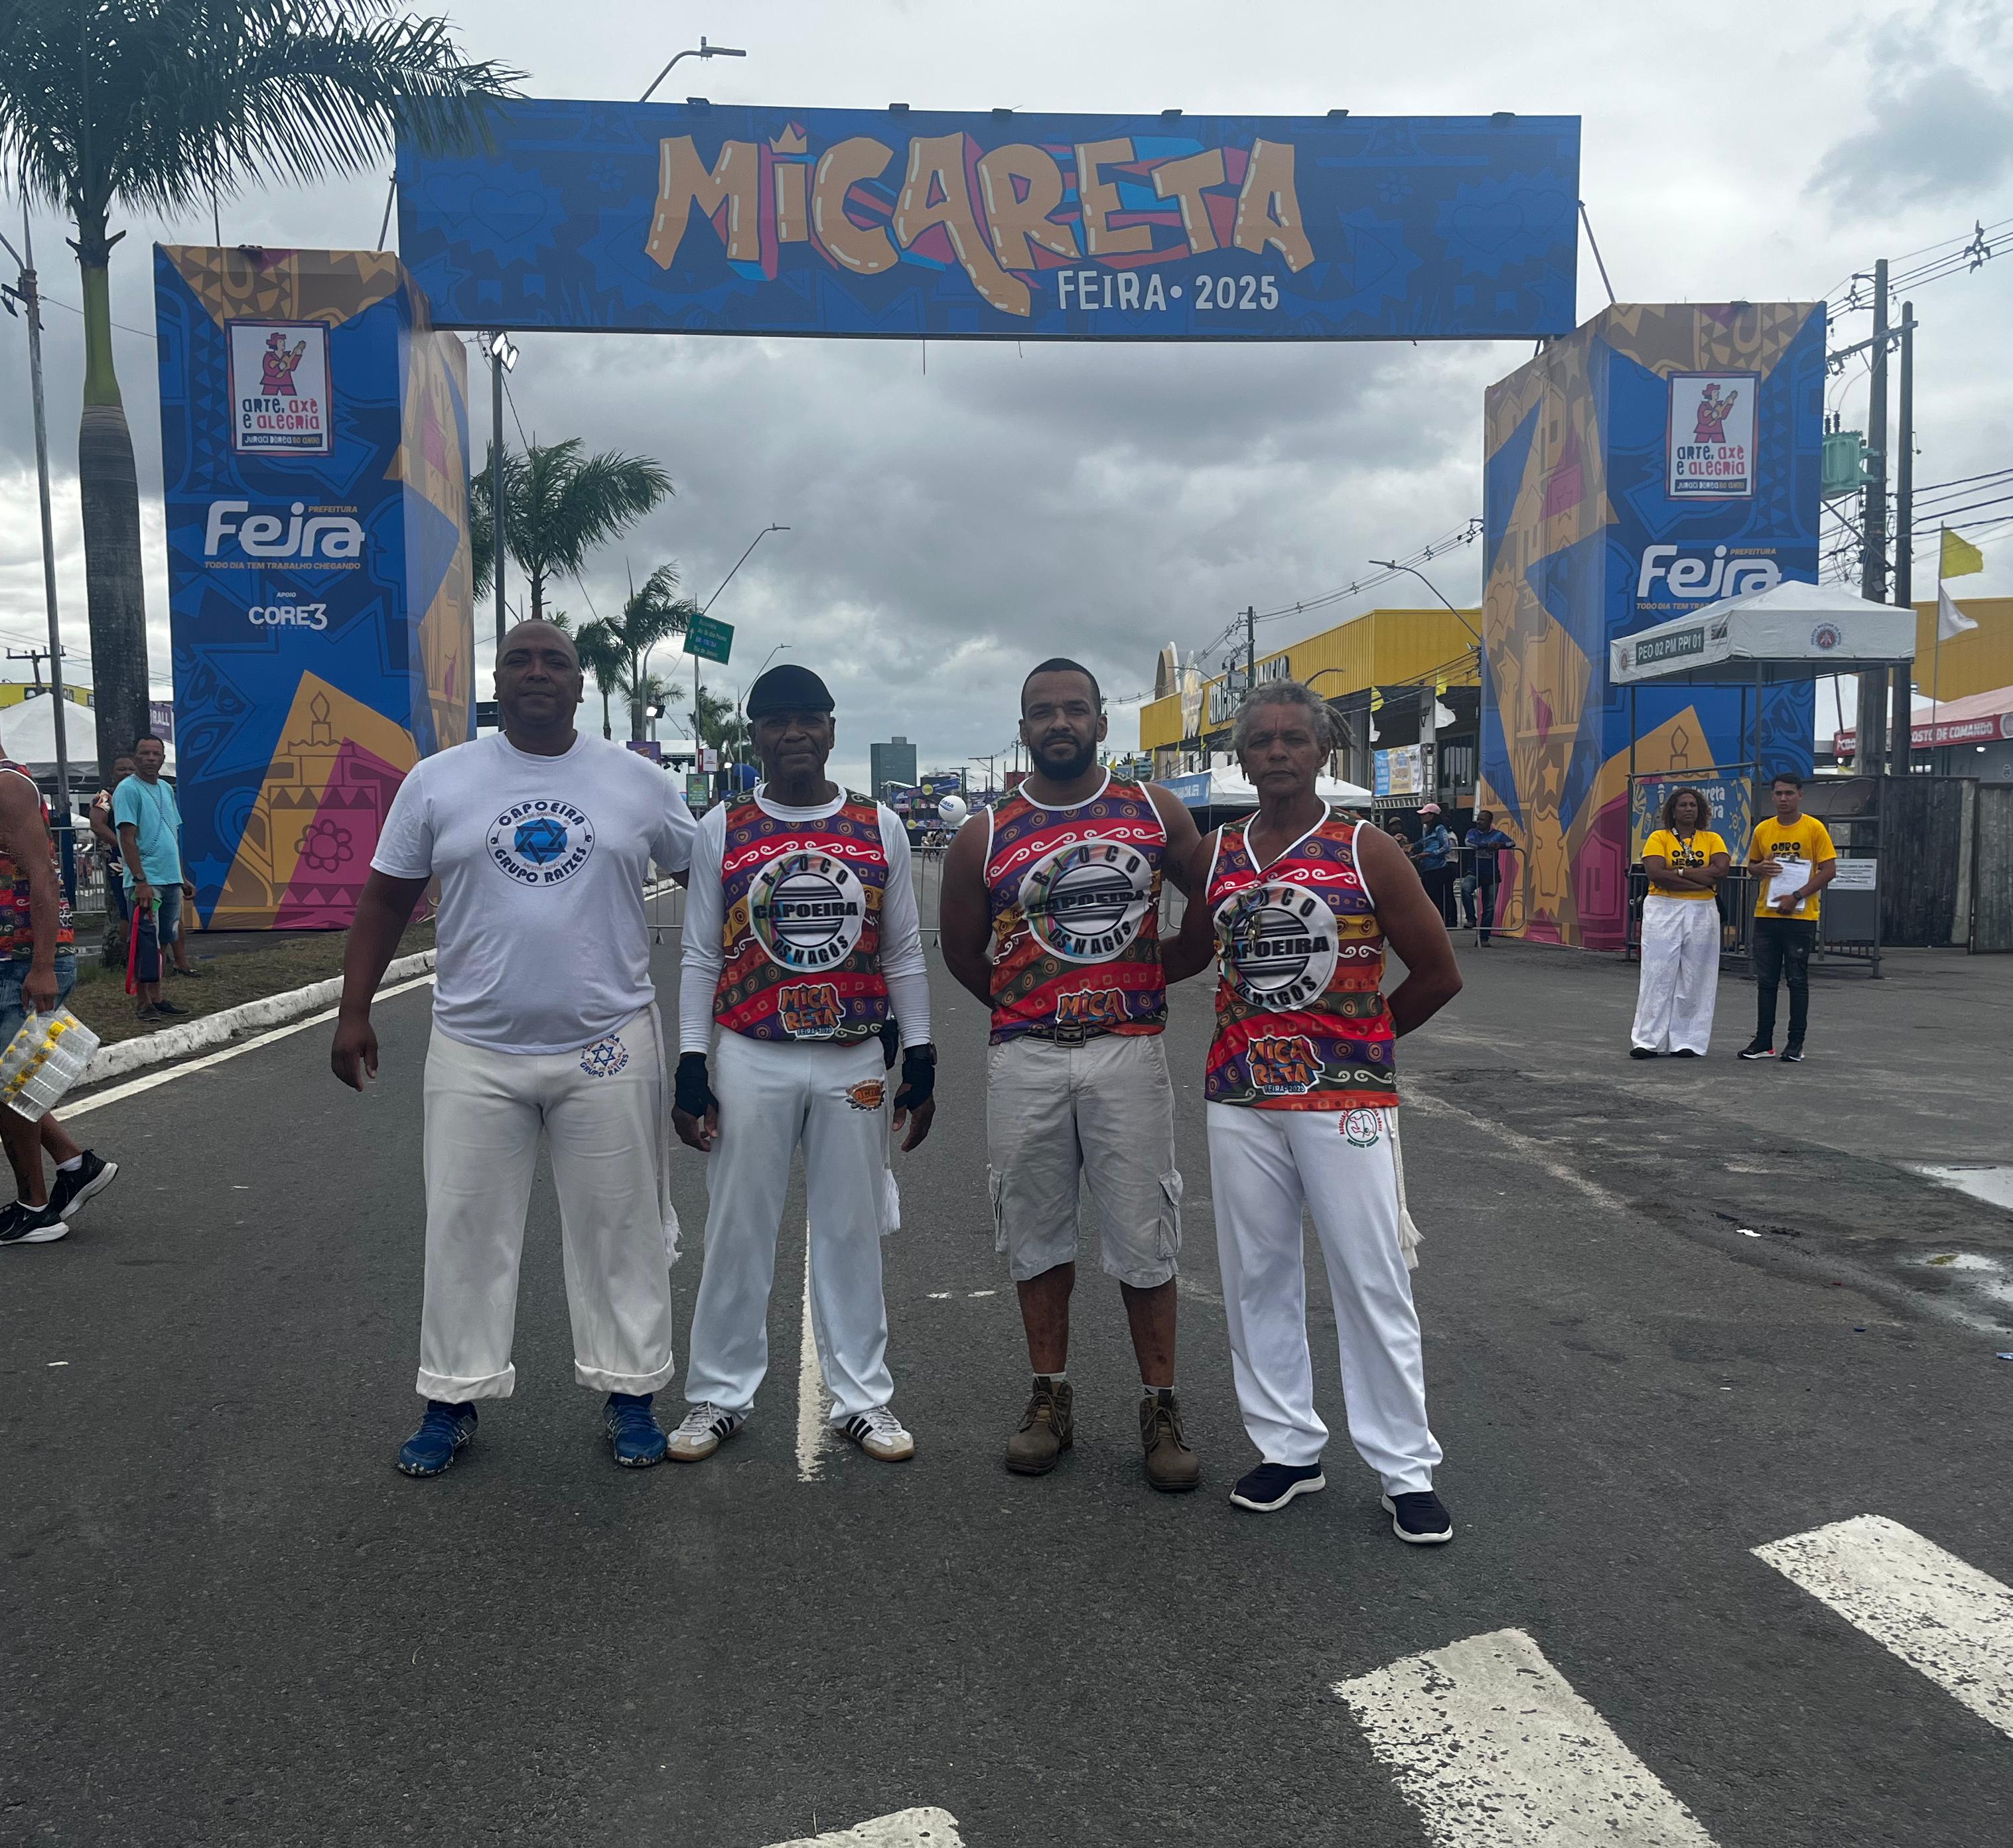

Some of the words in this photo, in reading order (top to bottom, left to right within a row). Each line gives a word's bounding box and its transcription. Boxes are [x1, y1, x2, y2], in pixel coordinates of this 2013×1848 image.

[644, 123, 1314, 316] MICARETA
[1058, 270, 1166, 311] FEIRA
[1195, 274, 1279, 310] 2025
[204, 500, 365, 558] Feira
[1637, 545, 1782, 598] Feira
[248, 603, 328, 631] CORE3
[1638, 644, 1653, 660] PEO
[1655, 641, 1664, 656] 02
[1665, 638, 1677, 653] PM
[1679, 635, 1691, 651] PPI
[1693, 633, 1701, 648] 01
[1911, 730, 1935, 743] OSTO
[1937, 728, 1948, 740] DE
[1949, 722, 1993, 738] COMANDO
[498, 801, 585, 826] CAPOEIRA
[494, 848, 539, 883] GRUPO
[544, 847, 587, 883] RAÍZES
[761, 854, 849, 888] BLOCO
[1030, 845, 1141, 887] BLOCO
[753, 902, 859, 919] CAPOEIRA
[772, 939, 792, 957] OS
[580, 1062, 604, 1077] GRUPO
